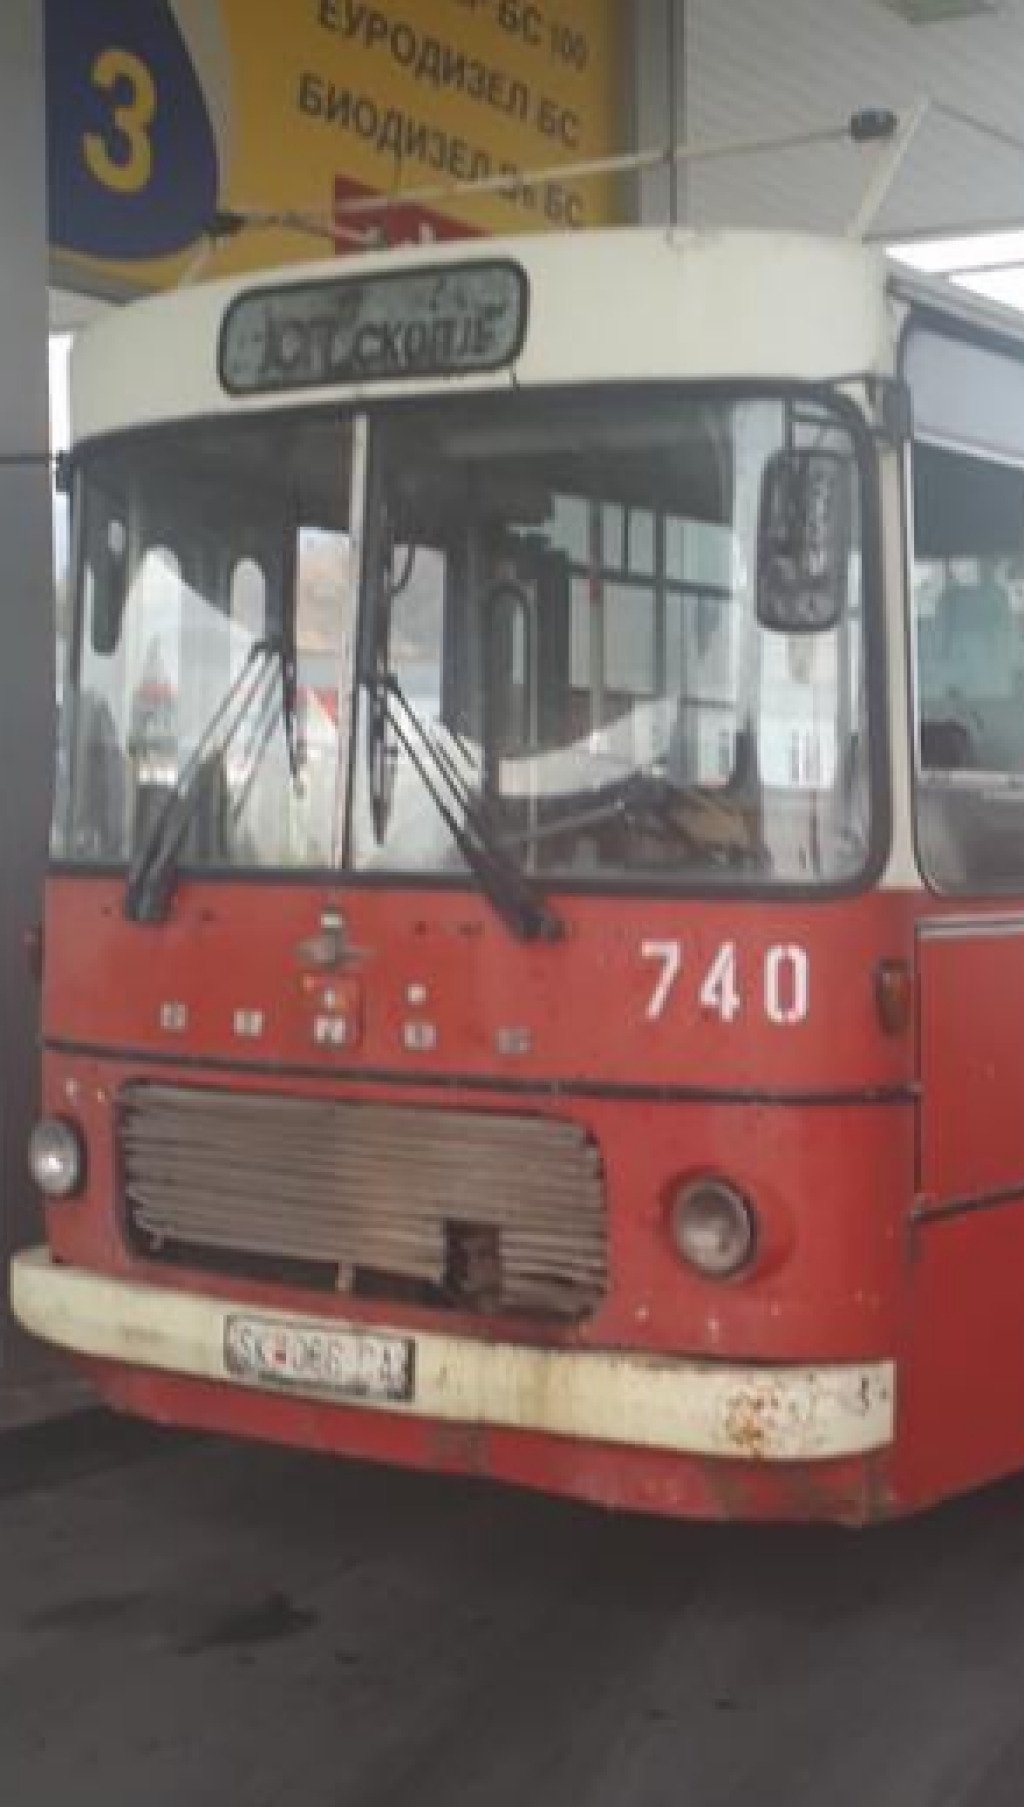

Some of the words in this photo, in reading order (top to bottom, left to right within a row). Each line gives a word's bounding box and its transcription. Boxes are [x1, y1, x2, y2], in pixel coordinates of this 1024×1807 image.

[83, 49, 157, 192] 3
[299, 72, 490, 180] БИОДИЗЕЛ
[537, 97, 578, 148] БС
[641, 938, 808, 1023] 740
